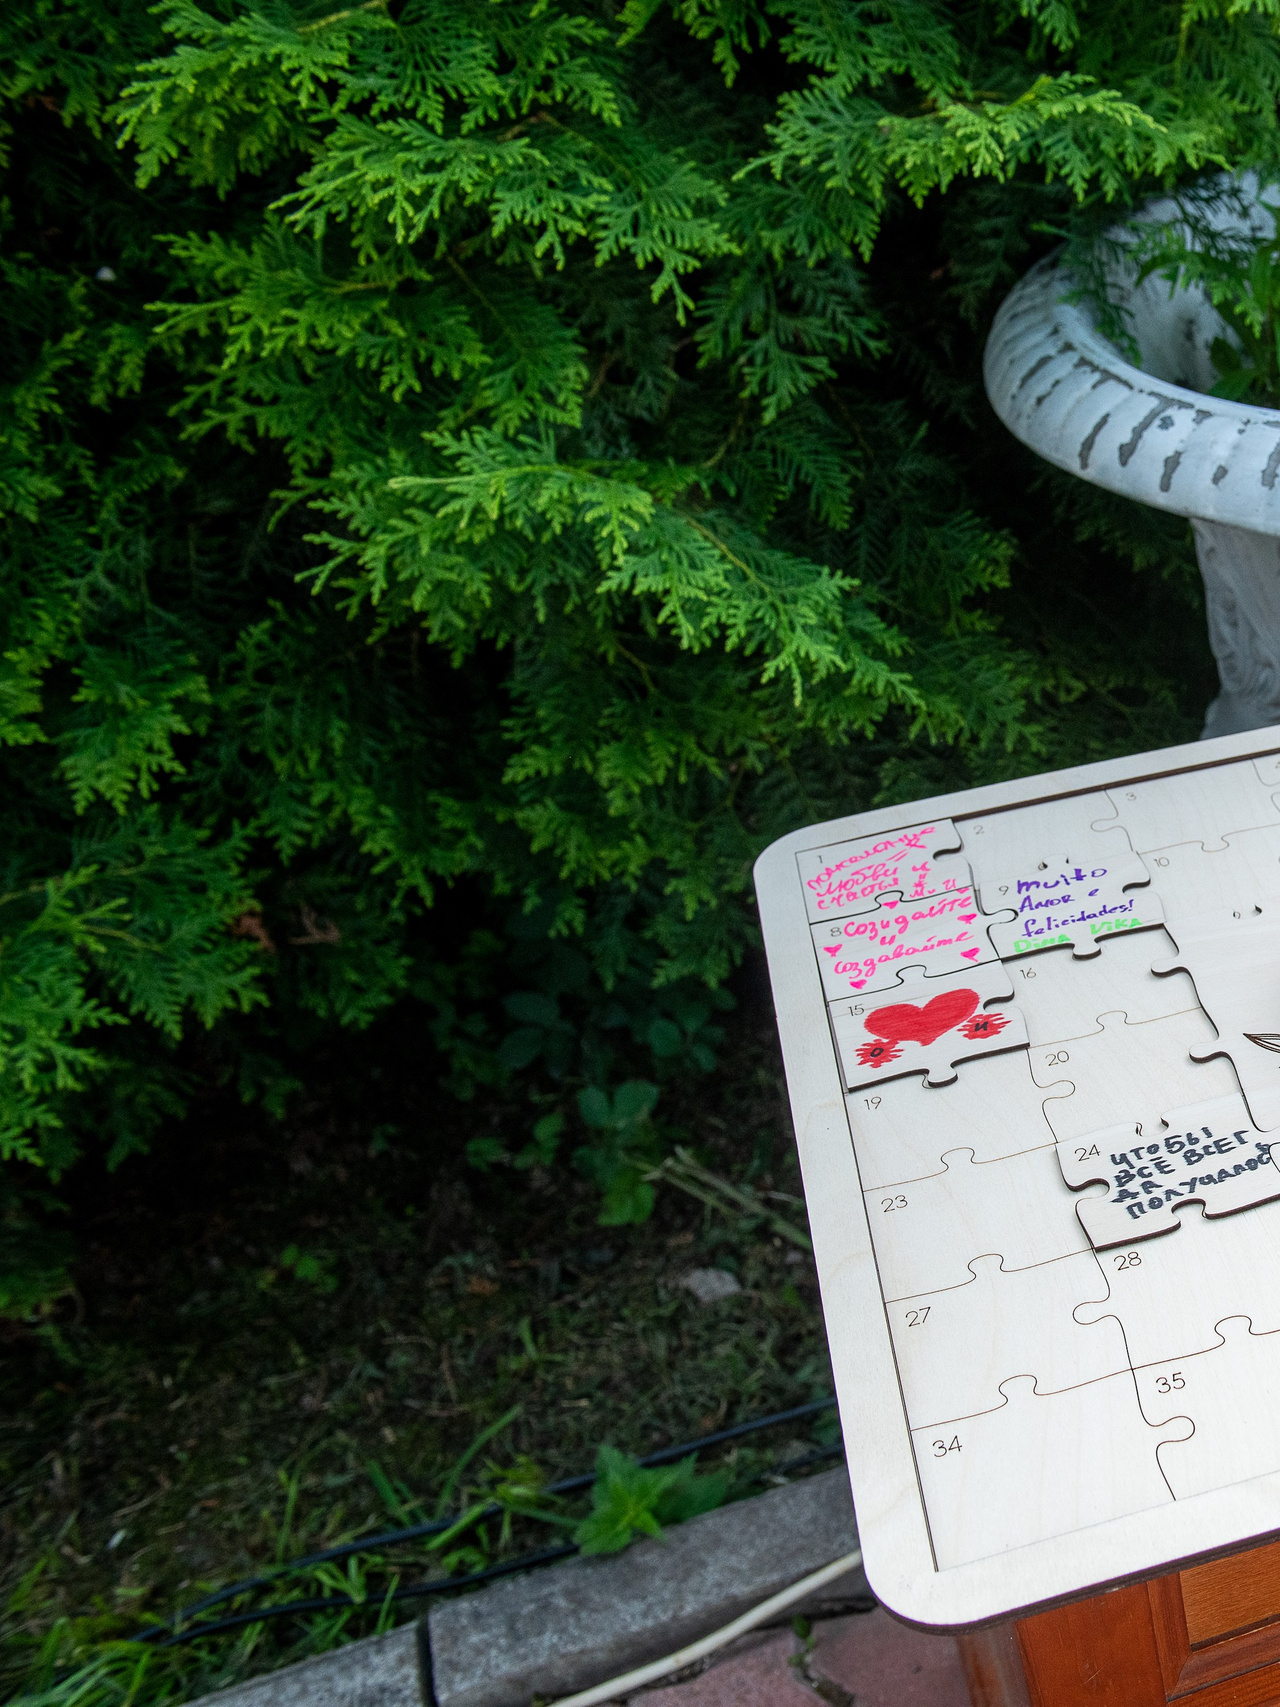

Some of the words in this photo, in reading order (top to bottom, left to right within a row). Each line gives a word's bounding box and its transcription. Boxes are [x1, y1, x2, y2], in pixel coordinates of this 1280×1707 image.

[1125, 792, 1137, 801] 3
[973, 825, 985, 835] 2
[818, 855, 824, 864] 1
[1154, 857, 1170, 868] 10
[998, 885, 1009, 896] 9
[1021, 899, 1135, 937] felicidades!
[830, 927, 842, 937] 8
[1020, 967, 1037, 979] 16
[848, 1004, 865, 1017] 15
[1045, 1050, 1070, 1067] 20
[863, 1096, 882, 1111] 19
[1074, 1144, 1101, 1162] 24
[1109, 1126, 1213, 1169] ЧТОБЫ
[881, 1194, 908, 1213] 23
[1113, 1251, 1142, 1271] 28
[905, 1306, 931, 1327] 27
[1155, 1371, 1186, 1394] 35
[932, 1435, 963, 1458] 34
